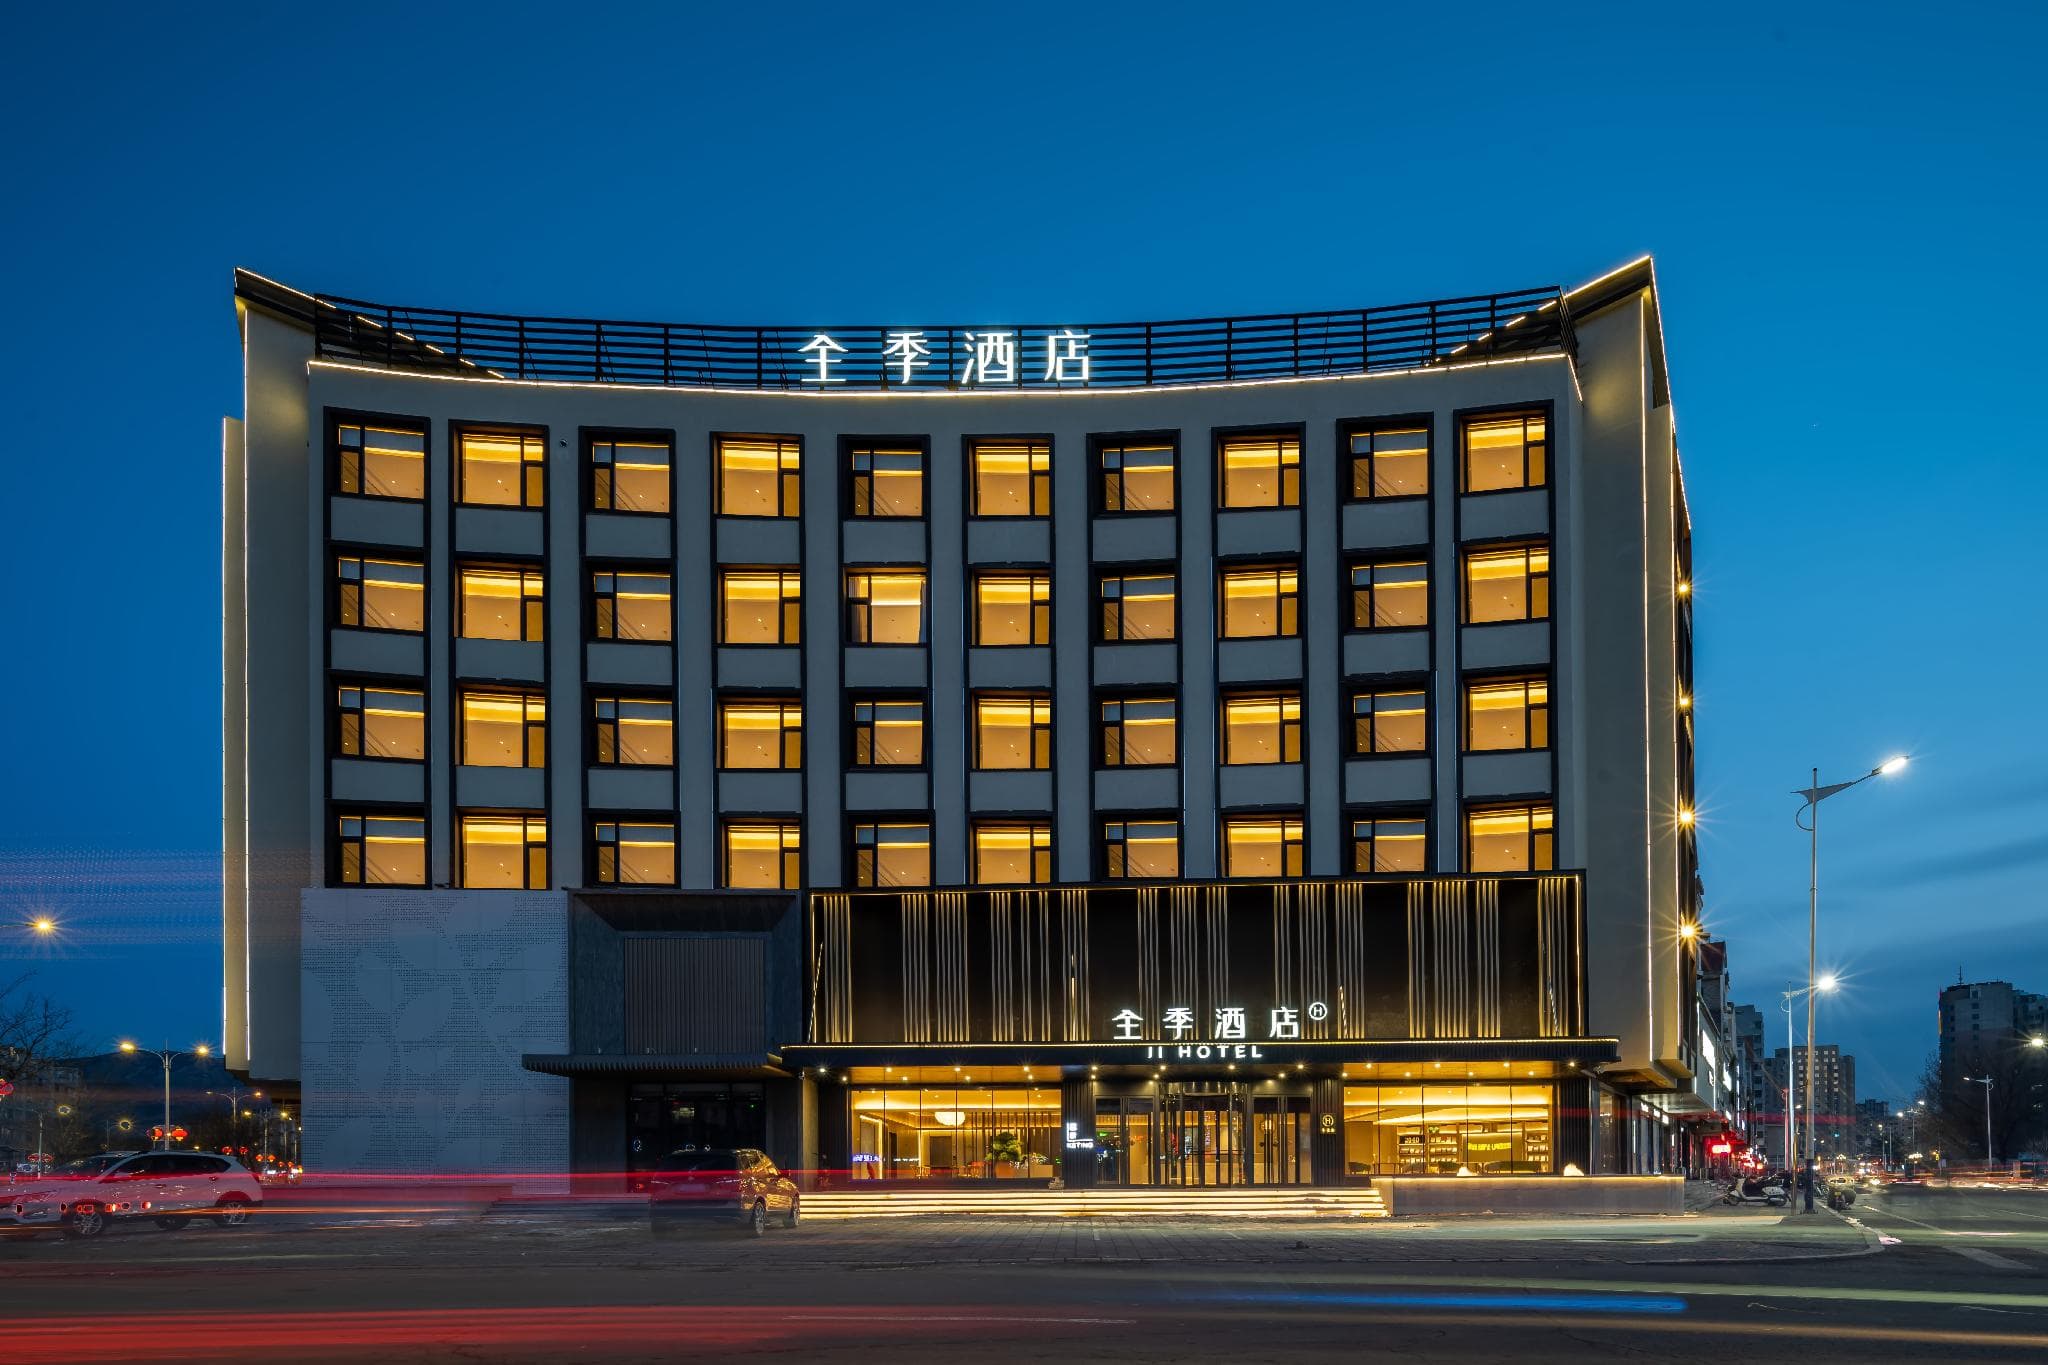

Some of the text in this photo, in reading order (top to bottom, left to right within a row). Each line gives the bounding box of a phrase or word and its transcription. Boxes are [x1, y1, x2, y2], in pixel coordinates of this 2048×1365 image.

[797, 330, 1092, 384] 全季酒店
[1111, 1006, 1299, 1040] 全季酒店
[1147, 1045, 1263, 1059] JI HOTEL
